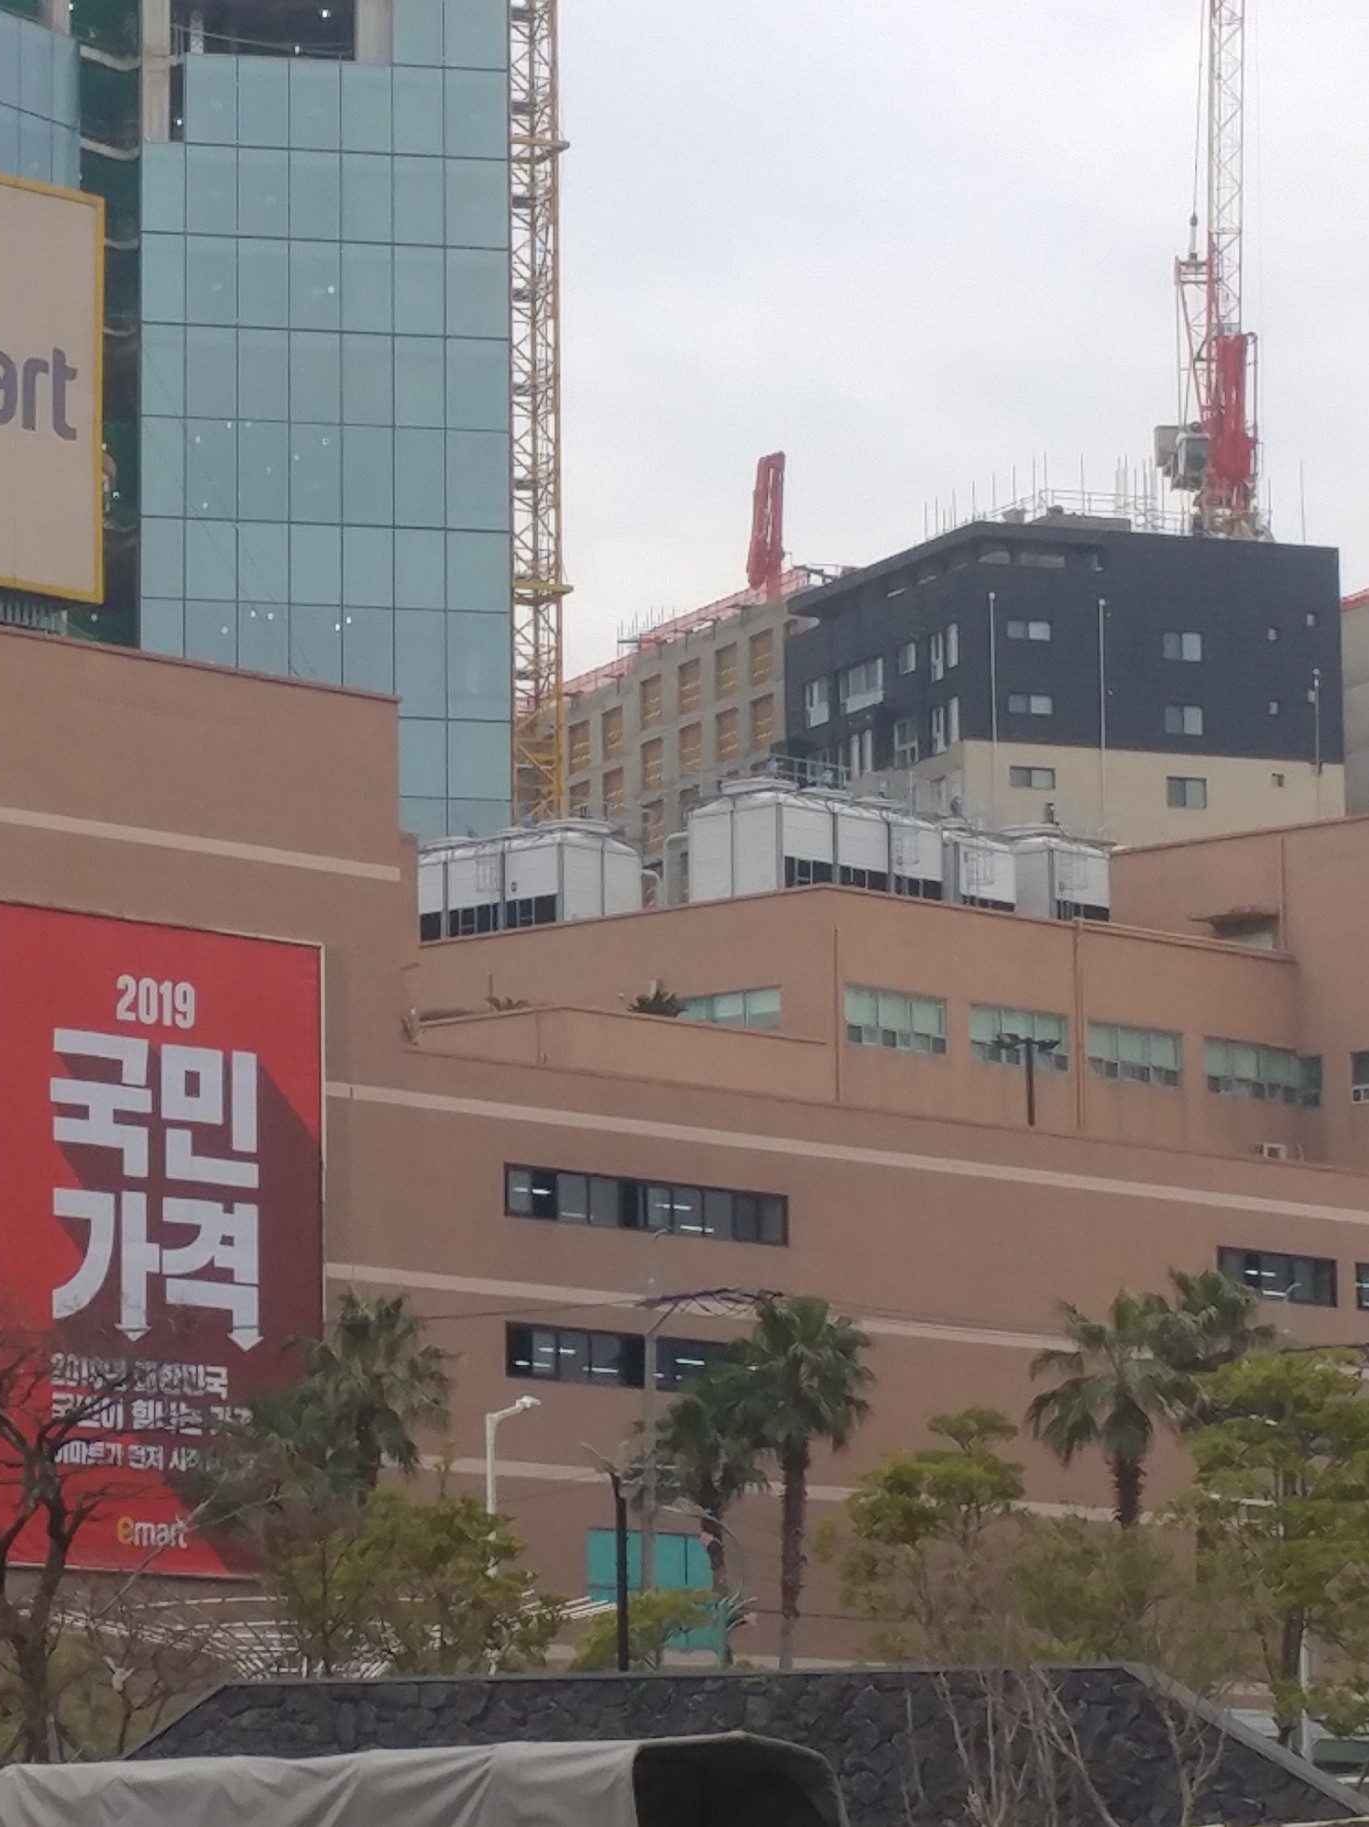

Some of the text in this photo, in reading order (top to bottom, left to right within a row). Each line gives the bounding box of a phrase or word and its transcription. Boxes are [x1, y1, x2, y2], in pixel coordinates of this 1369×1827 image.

[116, 974, 196, 1029] 2019
[50, 1028, 259, 1188] 국민
[52, 1187, 263, 1351] 가격
[133, 1359, 228, 1400] 대한민국
[117, 1514, 188, 1549] emart
